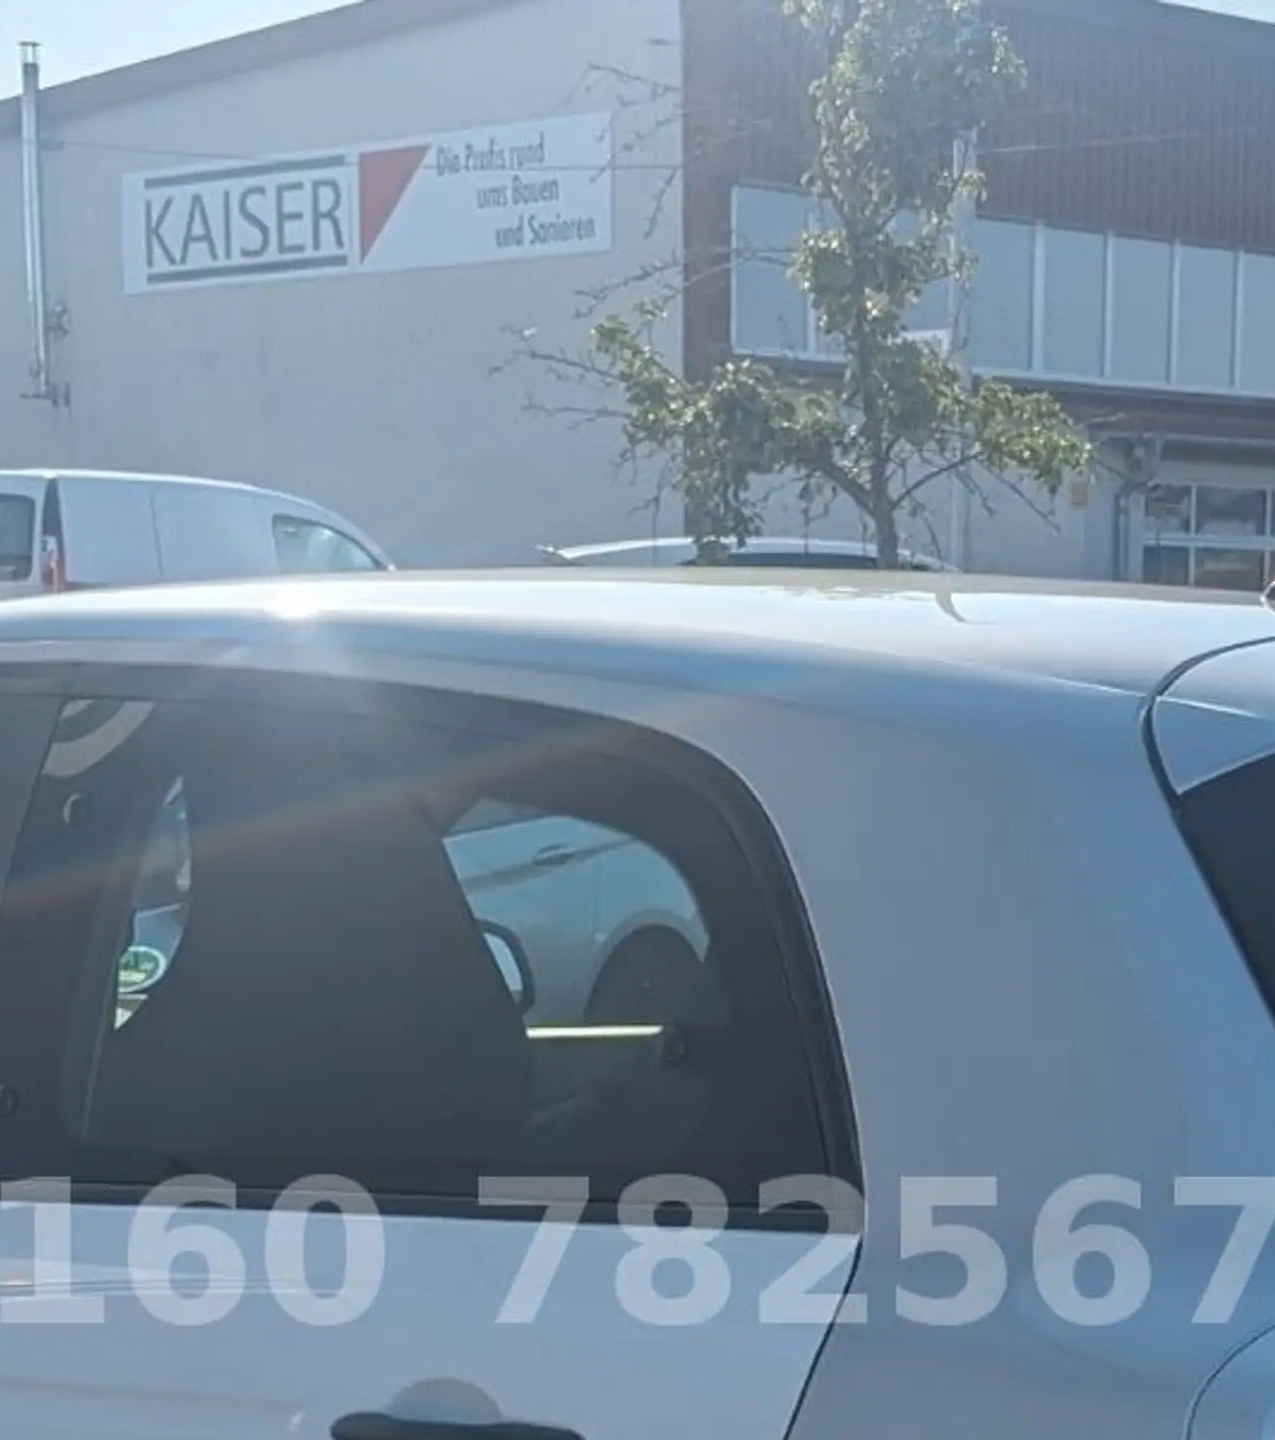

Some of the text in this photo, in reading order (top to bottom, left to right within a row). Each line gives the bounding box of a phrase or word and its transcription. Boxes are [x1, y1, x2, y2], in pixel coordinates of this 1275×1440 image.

[436, 130, 545, 176] Die Profis rund
[477, 173, 560, 210] ums Bauen
[143, 177, 345, 268] KAISER
[494, 212, 596, 248] und Sanieren
